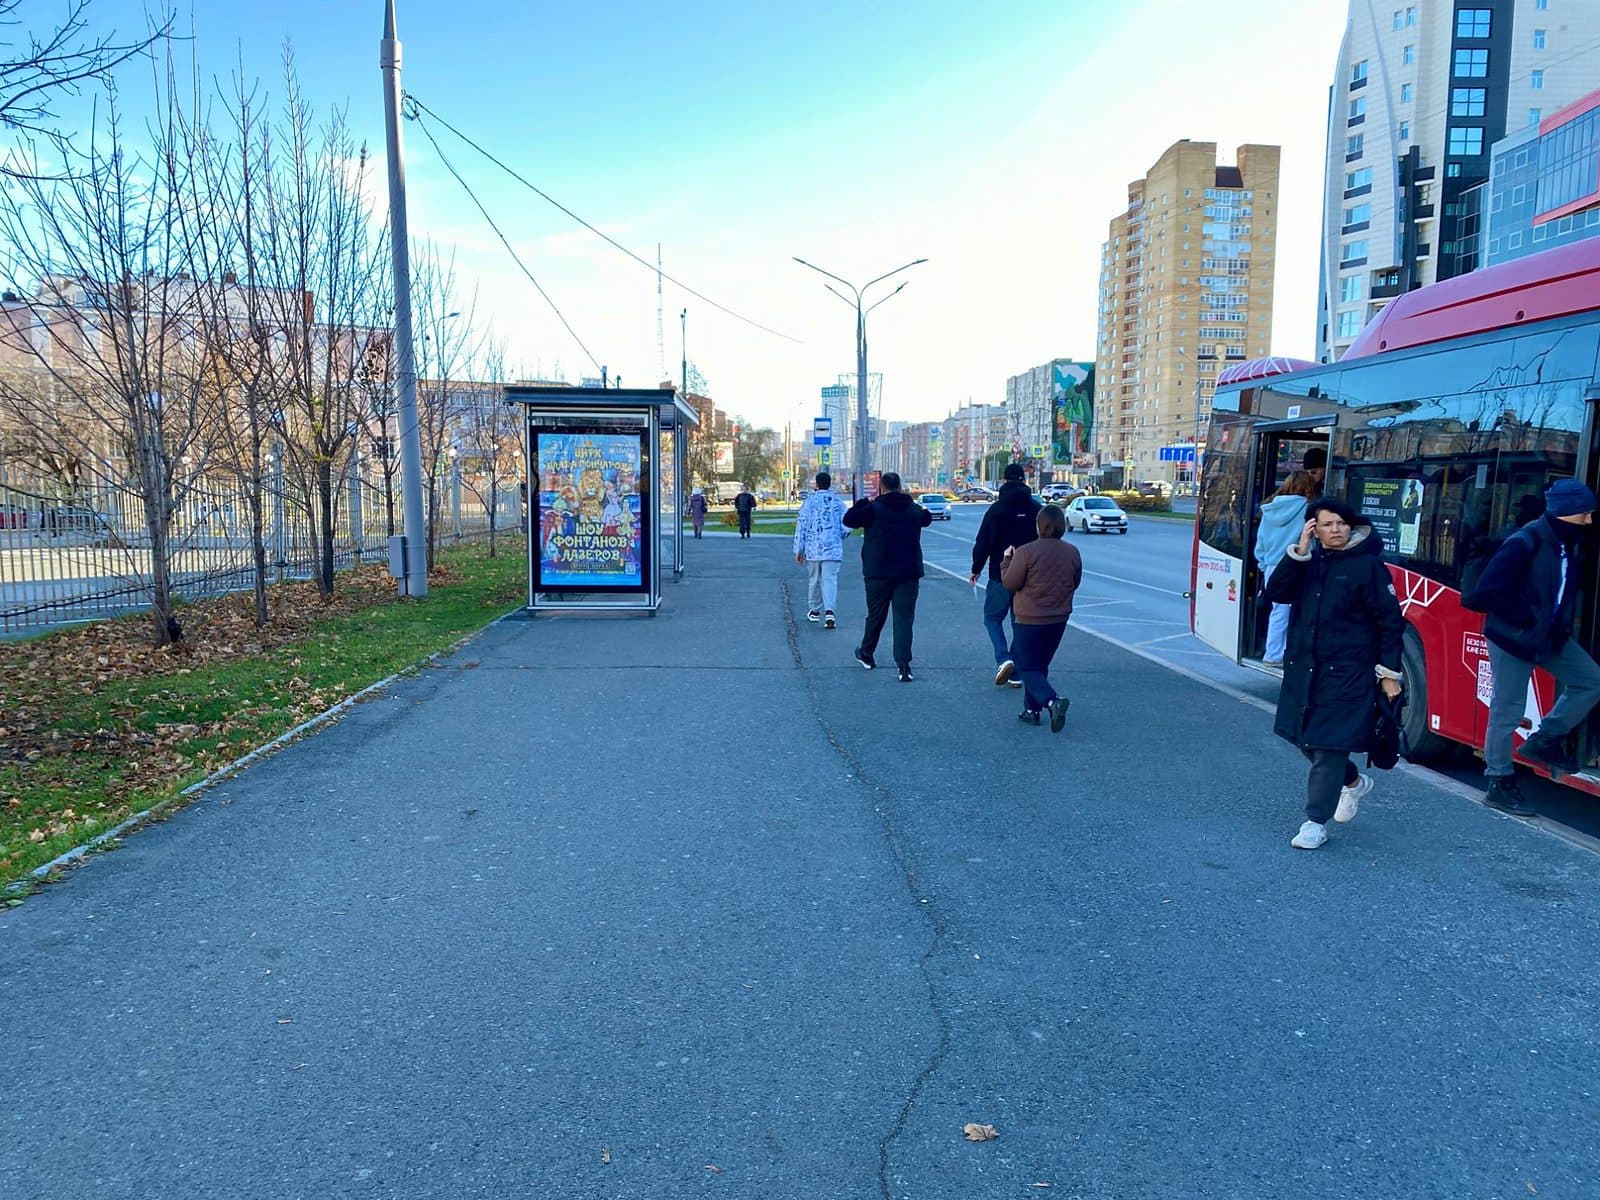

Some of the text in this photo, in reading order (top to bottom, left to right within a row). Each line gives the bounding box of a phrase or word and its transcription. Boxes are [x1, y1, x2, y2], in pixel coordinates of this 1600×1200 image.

[551, 440, 563, 449] 31
[575, 522, 604, 535] ШОУ
[553, 535, 628, 549] ФОНТАНОВ
[561, 549, 620, 562] ЛАЗЕРОВ
